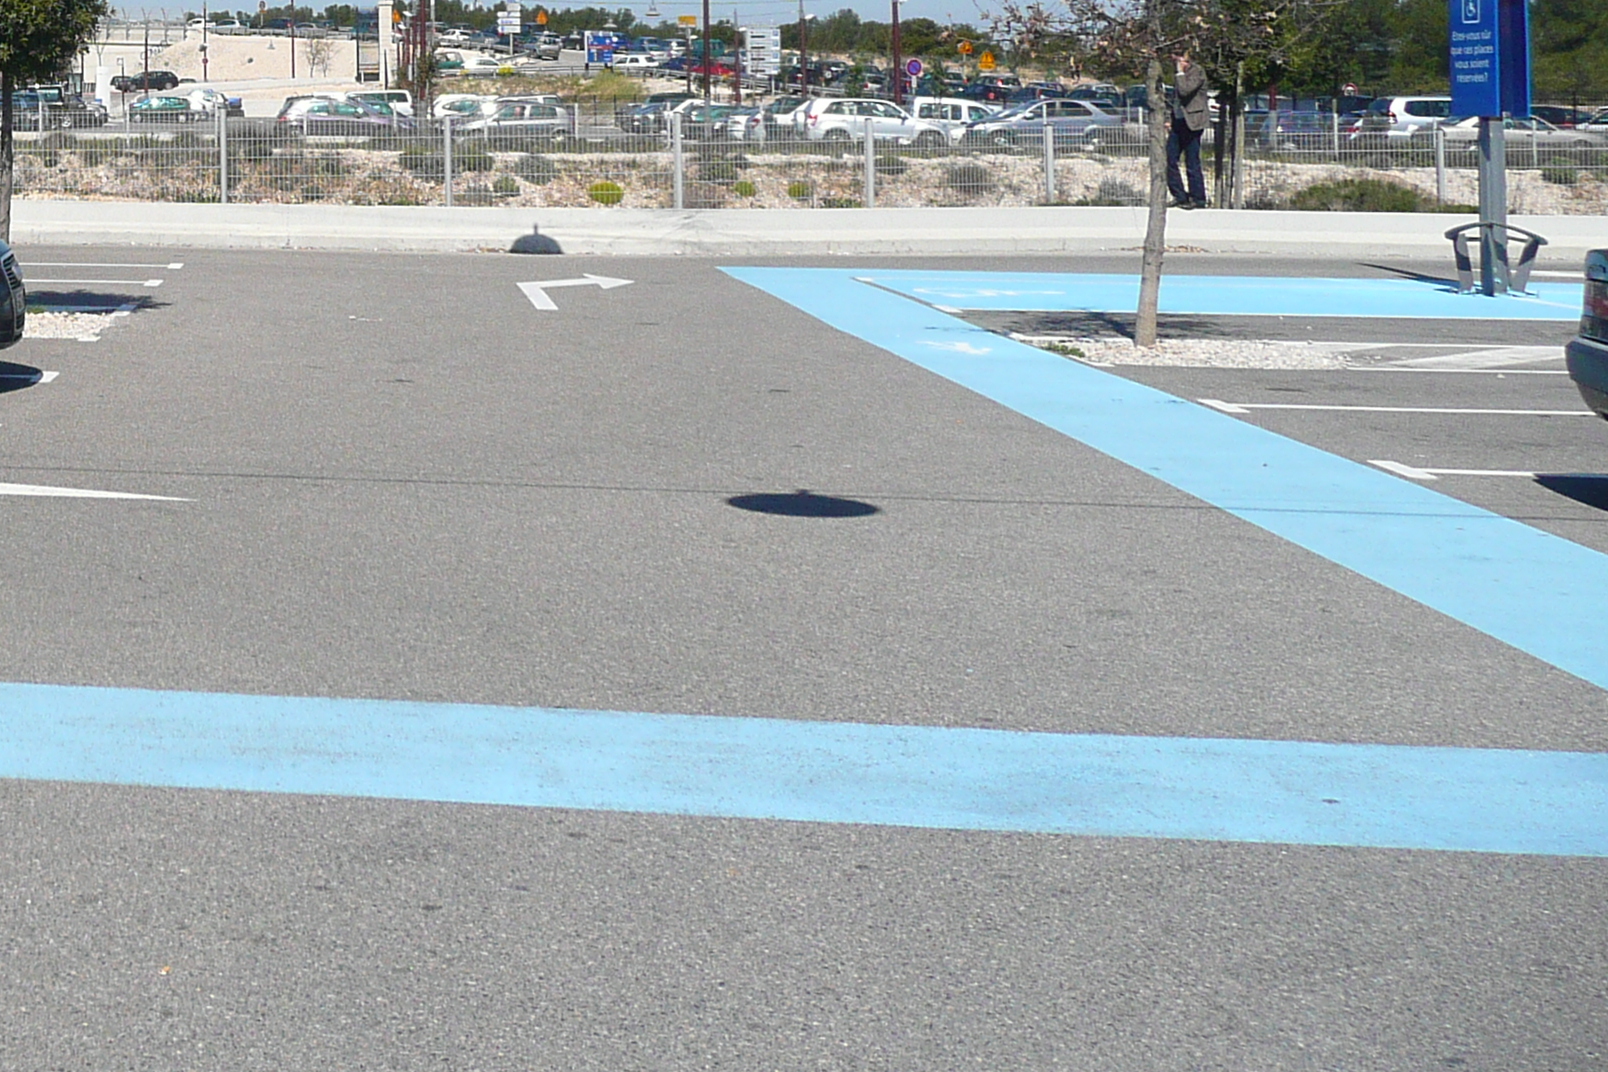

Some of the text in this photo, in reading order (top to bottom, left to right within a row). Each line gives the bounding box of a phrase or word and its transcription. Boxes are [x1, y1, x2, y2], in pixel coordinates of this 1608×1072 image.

[1451, 47, 1462, 57] que
[1474, 44, 1493, 56] places
[1455, 58, 1489, 69] vous soient
